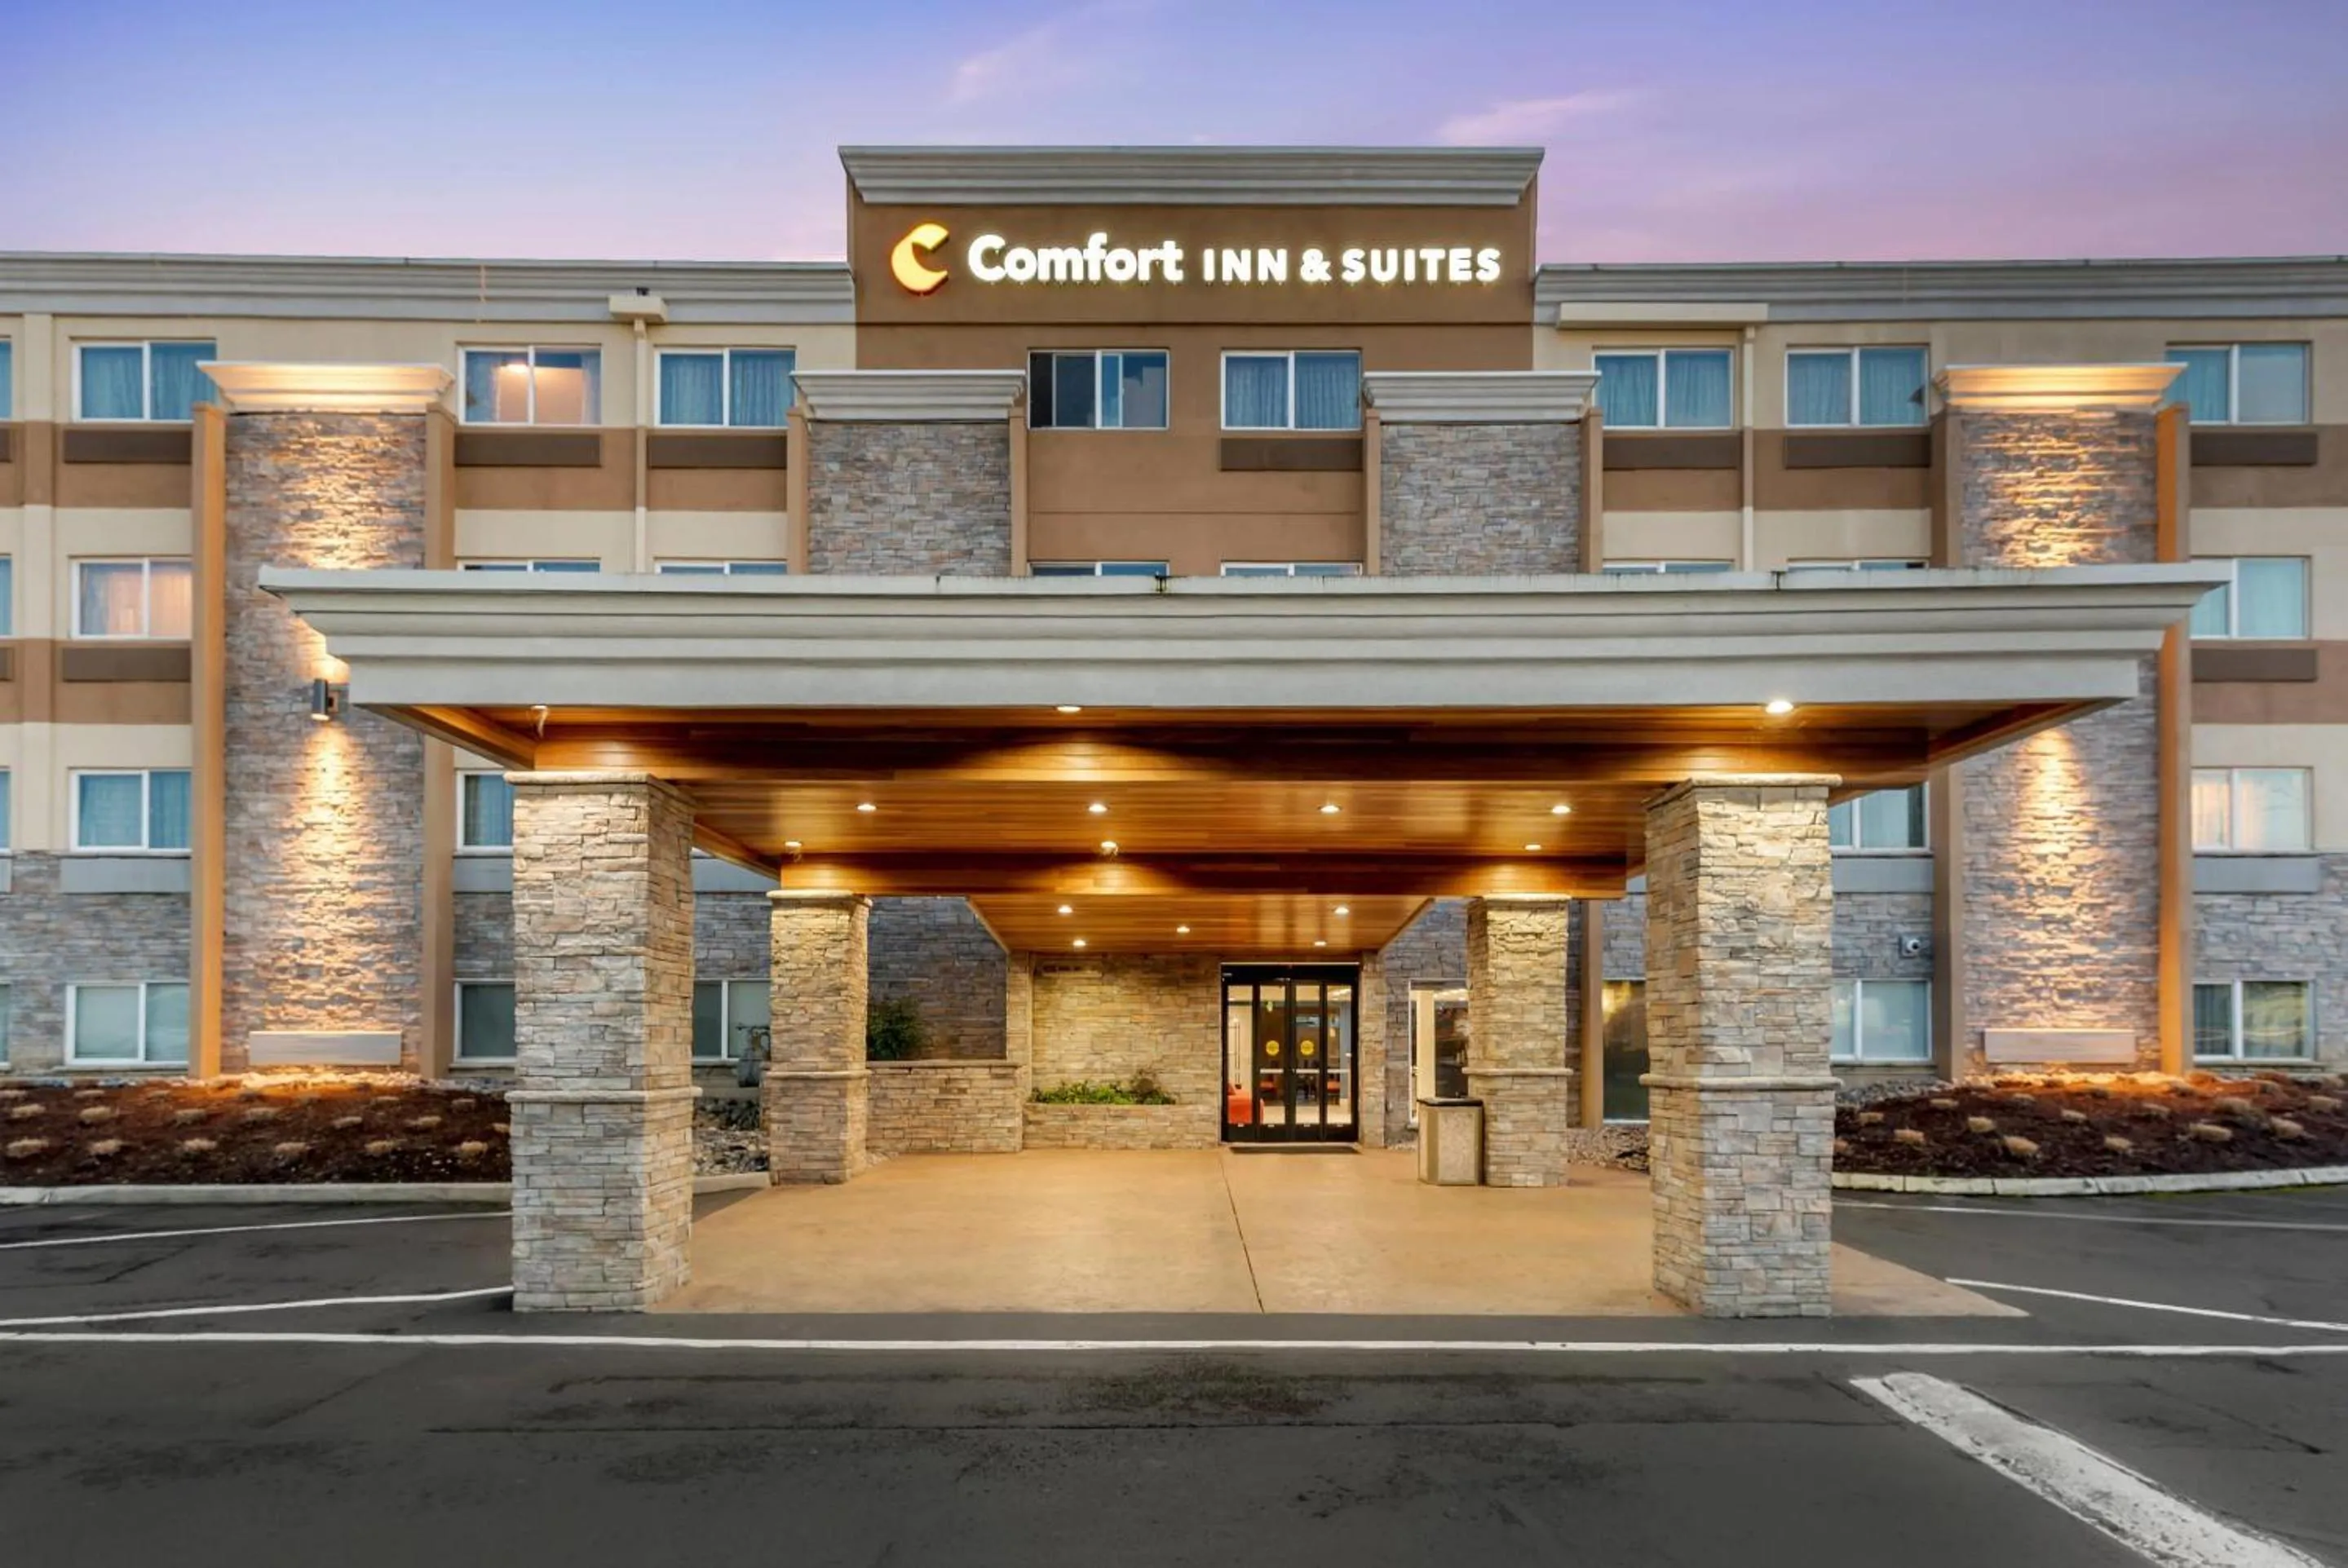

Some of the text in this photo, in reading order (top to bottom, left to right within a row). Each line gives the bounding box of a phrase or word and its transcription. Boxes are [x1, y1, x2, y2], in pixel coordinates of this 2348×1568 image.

[967, 232, 1501, 284] Comfort INN & SUITES
